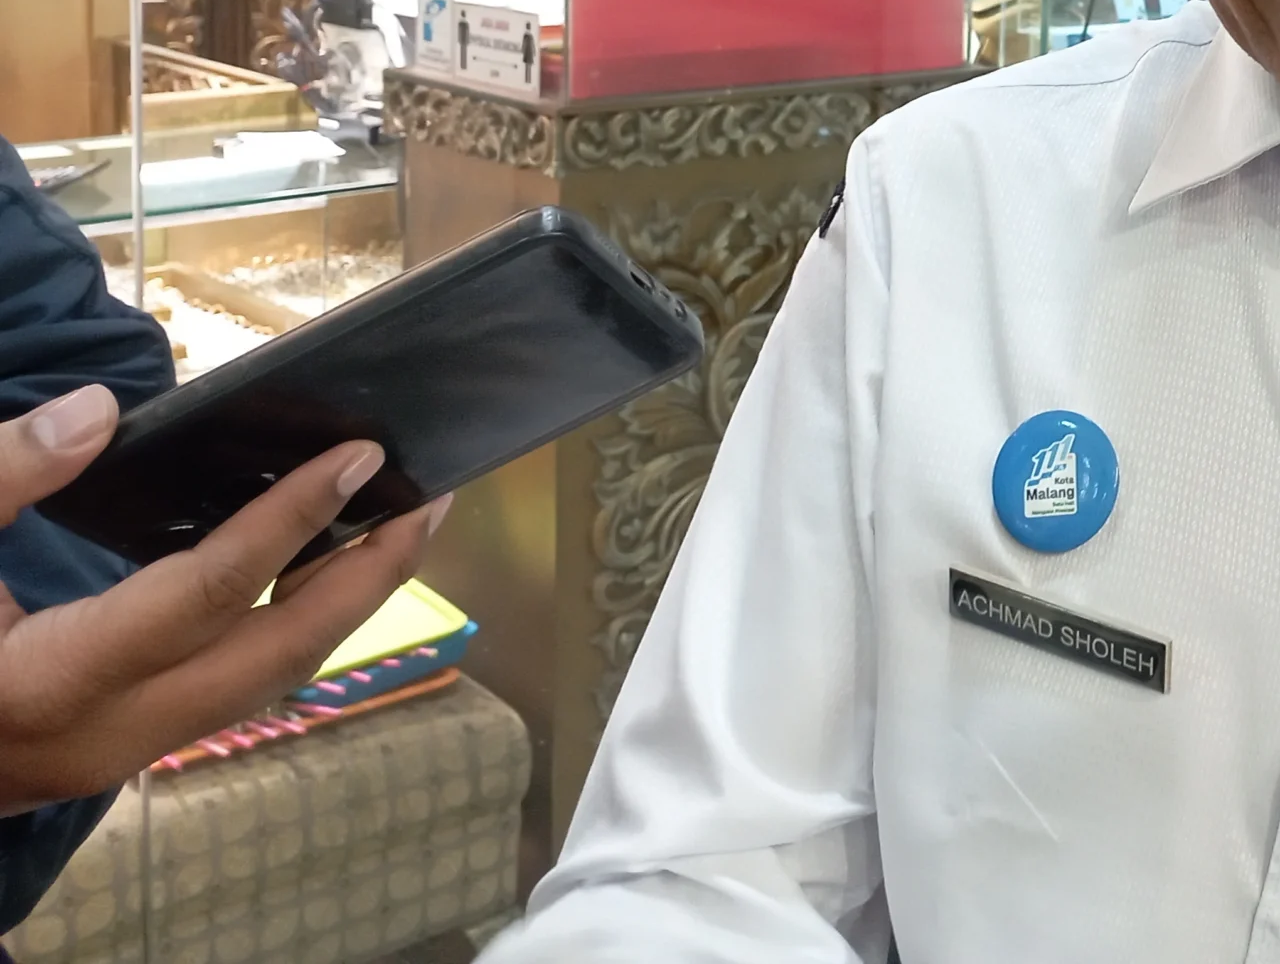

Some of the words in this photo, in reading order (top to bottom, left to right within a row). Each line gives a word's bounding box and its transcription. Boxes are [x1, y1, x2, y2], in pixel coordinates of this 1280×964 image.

[1054, 476, 1074, 485] Kota
[1026, 487, 1075, 501] Malang
[957, 590, 1053, 638] ACHMAD
[1060, 625, 1154, 676] SHOLEH
